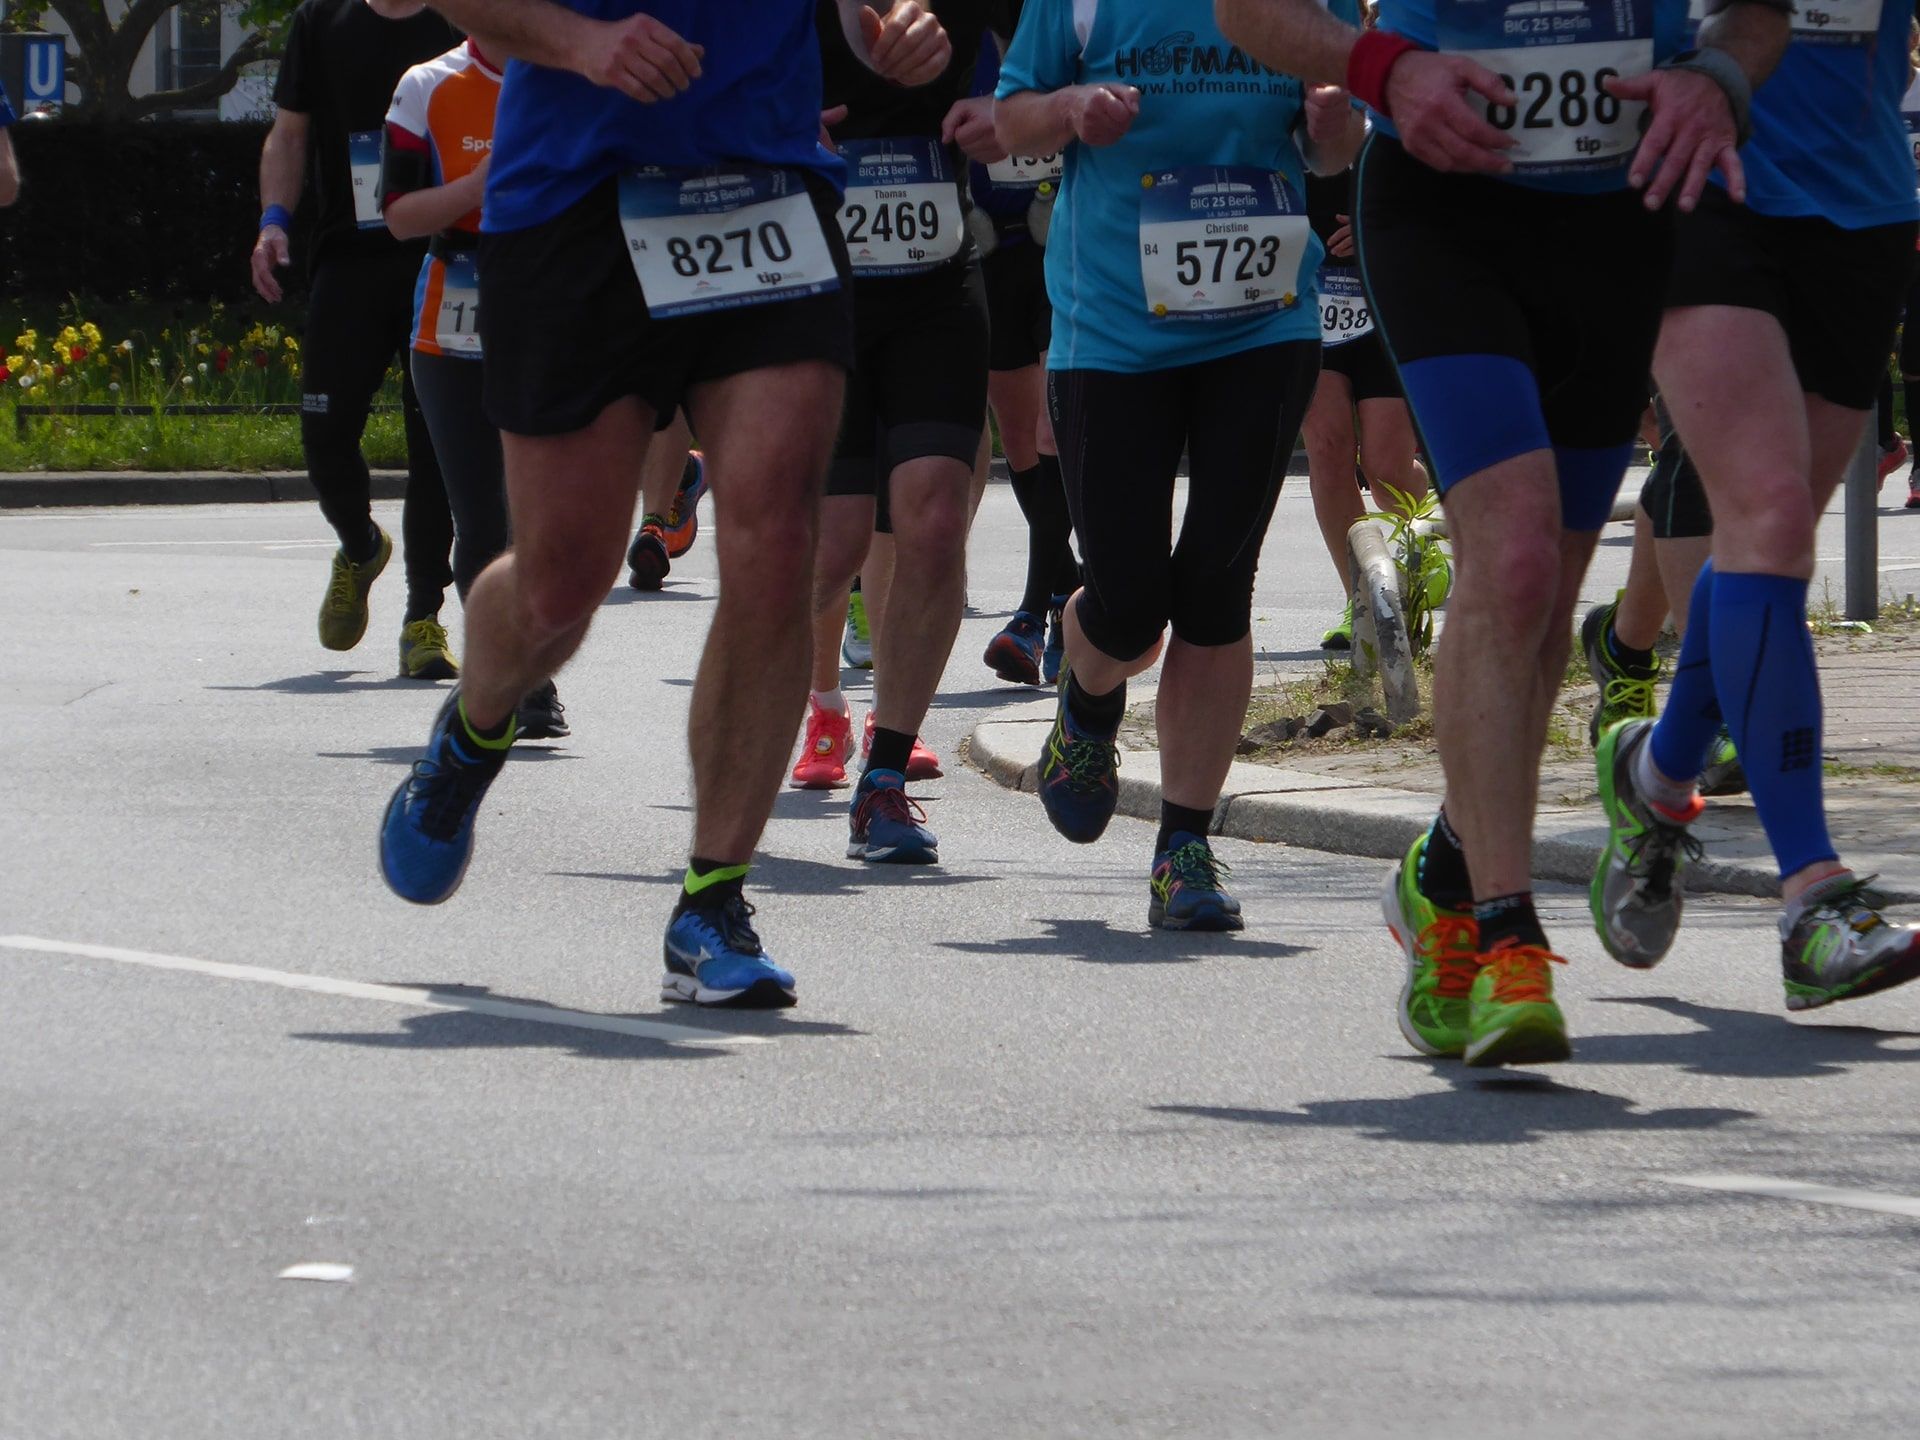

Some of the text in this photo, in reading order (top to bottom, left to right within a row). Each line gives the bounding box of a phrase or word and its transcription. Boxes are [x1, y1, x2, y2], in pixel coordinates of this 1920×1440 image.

[1504, 15, 1591, 34] BIG 25 Berlin
[30, 43, 58, 96] U
[1575, 136, 1601, 154] tip
[859, 165, 918, 177] BIG 25 Berlin
[680, 186, 754, 207] BIG 25 Berlin
[875, 189, 907, 200] Thomas
[1190, 195, 1258, 209] BIG 25 Berlin
[845, 200, 939, 244] 2469
[1206, 222, 1249, 235] Christine
[632, 239, 648, 251] B4
[667, 220, 792, 277] 8270
[1144, 243, 1158, 256] B4
[907, 246, 926, 261] tip
[1176, 235, 1281, 286] 5723
[757, 271, 782, 286] tip
[1244, 287, 1260, 301] tip
[1319, 304, 1369, 331] 938
